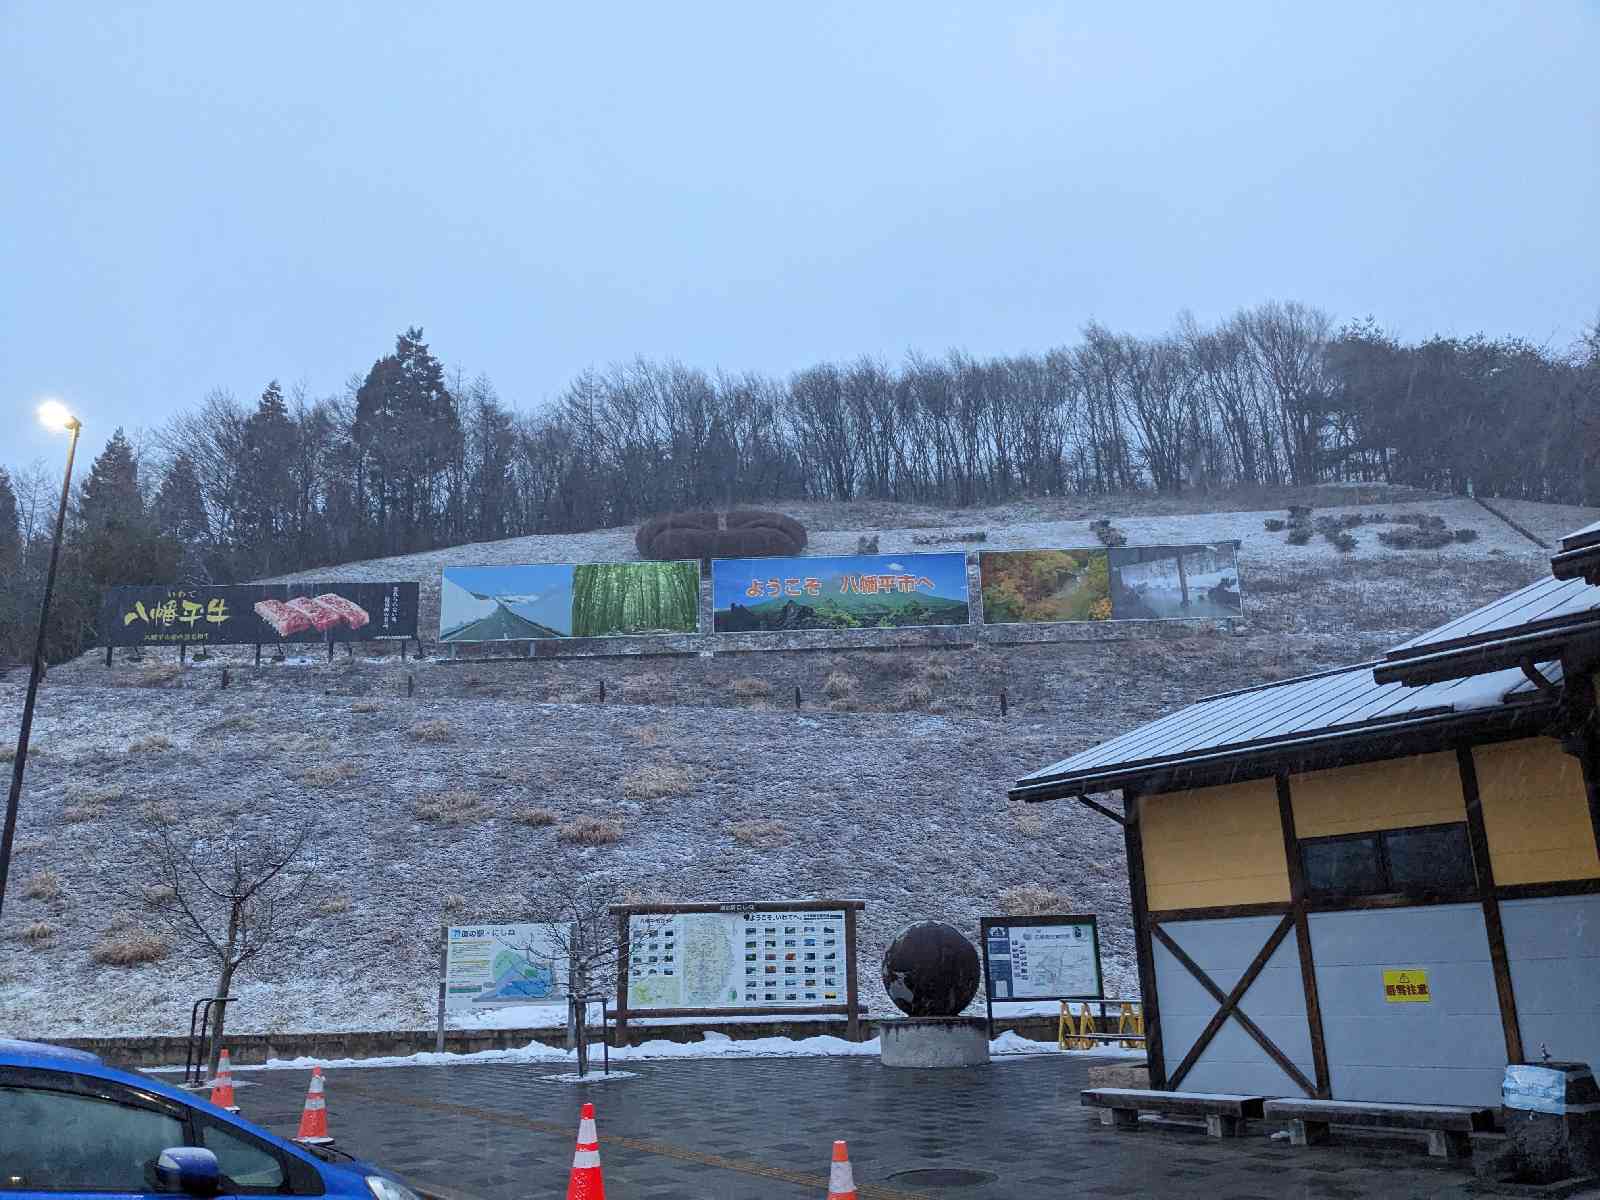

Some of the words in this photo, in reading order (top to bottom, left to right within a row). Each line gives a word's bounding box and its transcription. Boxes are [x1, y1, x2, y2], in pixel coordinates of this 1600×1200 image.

[167, 590, 197, 599] いわて
[745, 577, 822, 598] ようこそ
[840, 573, 936, 594] 八幡平市へ
[123, 598, 231, 629] 八幡平牛
